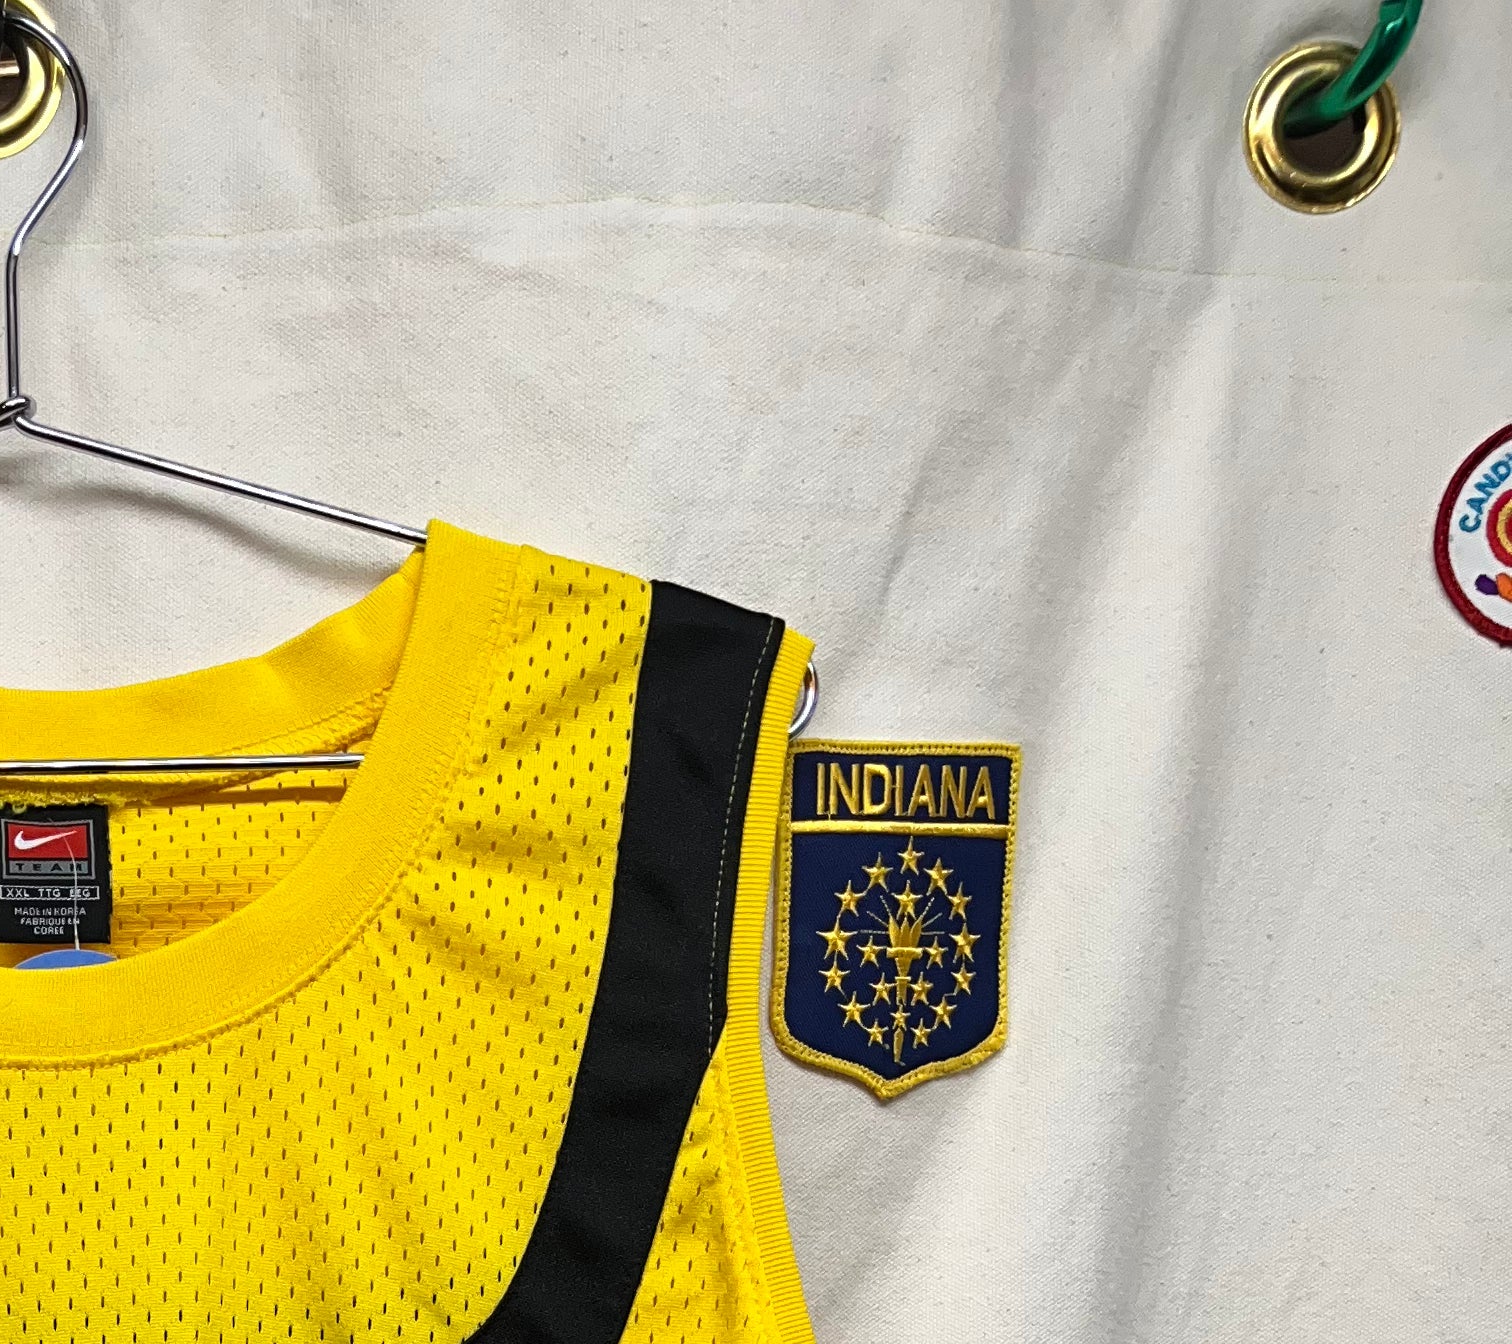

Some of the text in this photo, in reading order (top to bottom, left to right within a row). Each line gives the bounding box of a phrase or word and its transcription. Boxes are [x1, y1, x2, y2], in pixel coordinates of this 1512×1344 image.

[1458, 452, 1512, 533] CAND
[816, 762, 997, 820] INDIANA
[15, 863, 82, 872] TEAM
[6, 888, 30, 898] XXL
[38, 888, 61, 898] TTG
[14, 907, 41, 916] MADE
[42, 907, 52, 916] IN
